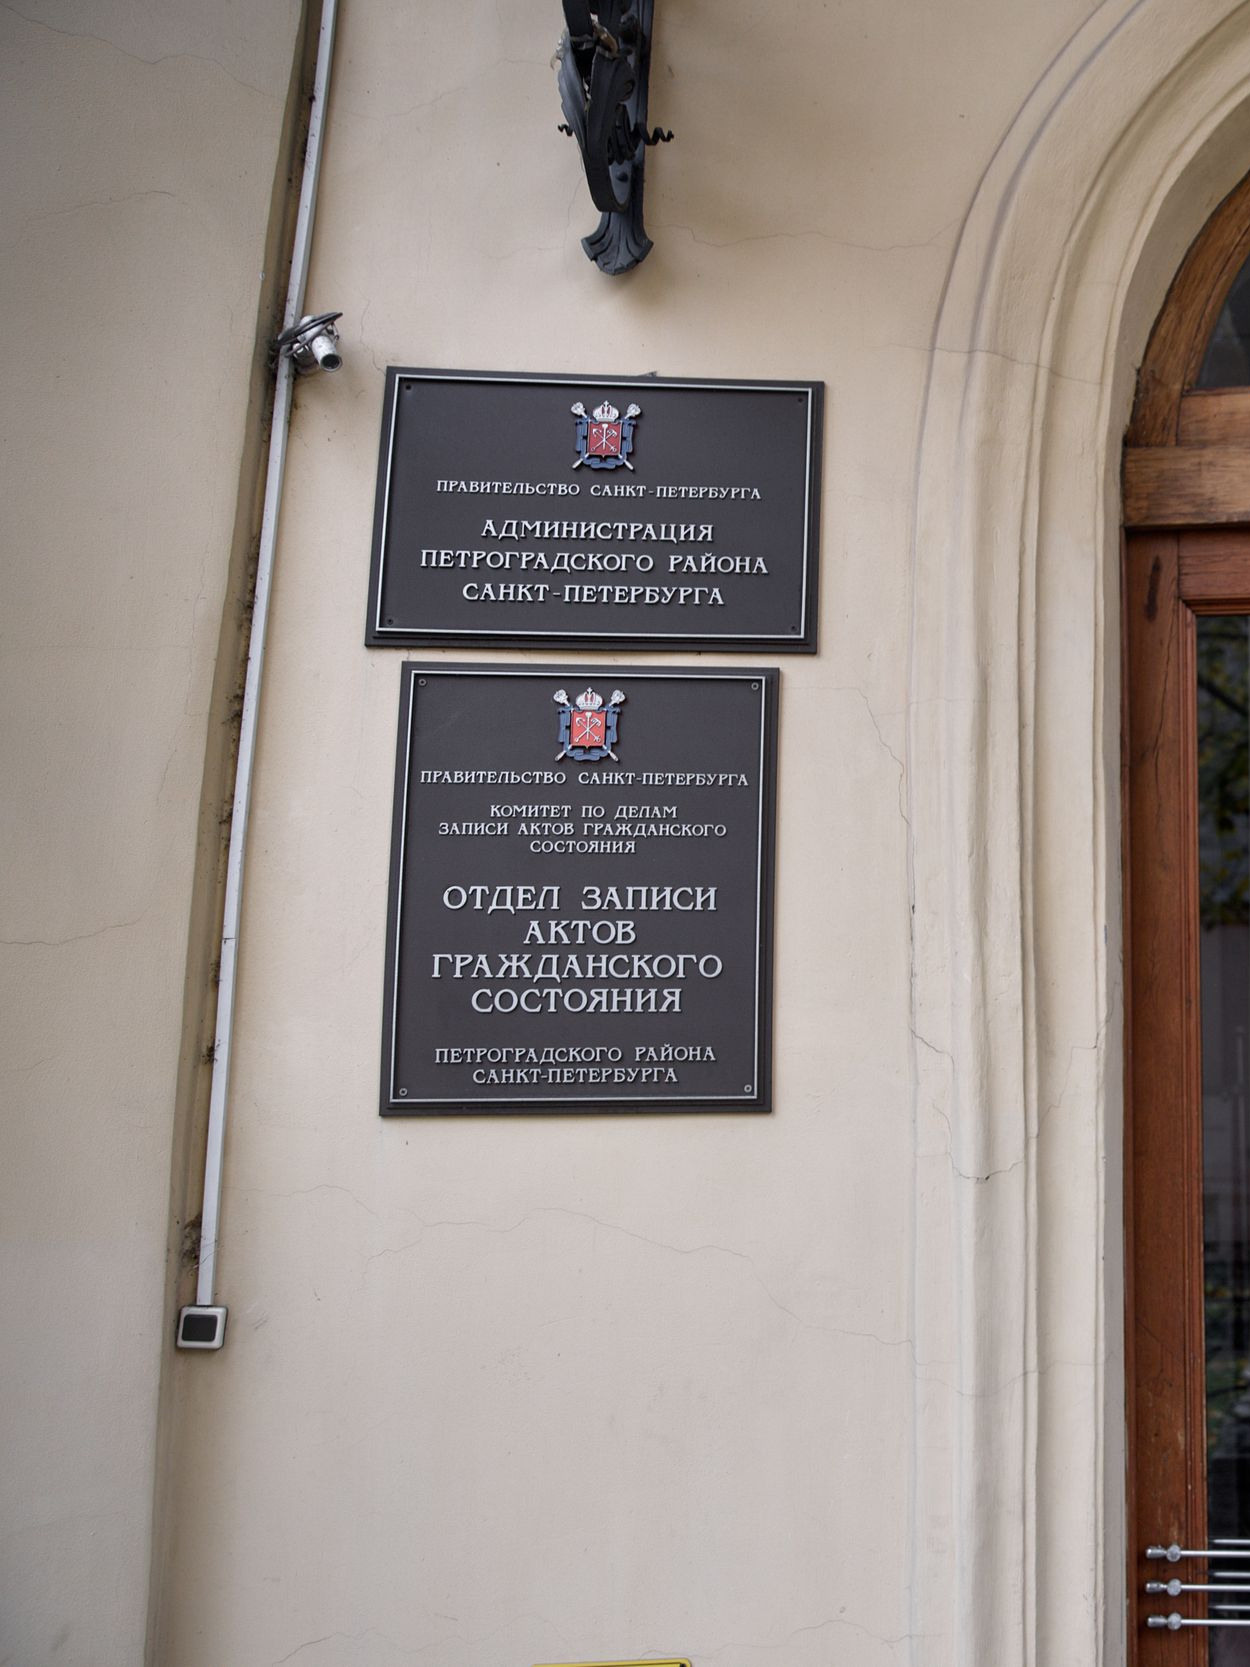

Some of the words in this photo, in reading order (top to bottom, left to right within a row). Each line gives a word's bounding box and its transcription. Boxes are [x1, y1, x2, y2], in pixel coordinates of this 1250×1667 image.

[436, 479, 580, 496] ПРАВИТЕЛЬСТВО
[590, 484, 761, 500] САНКТ-ПЕТЕРБУРГА
[481, 519, 714, 543] АДМИНИСТРАЦИЯ
[420, 549, 653, 572] ПЕТРОГРАДСКОГО
[668, 550, 768, 575] РАЙОНА
[462, 583, 724, 606] САНКТ-ПЕТЕРБУРГА
[420, 770, 566, 784] ПРАВИТЕЛЬСТВО
[578, 771, 749, 787] САНКТ-ПЕТЕРБУРГА
[490, 804, 571, 819] КОМИТЕТ
[581, 805, 604, 819] ПО
[615, 805, 677, 820] ДЕЛАМ
[438, 822, 508, 837] ЗАПИСИ
[518, 823, 574, 837] АКТОВ
[583, 823, 727, 838] ГРАЖДАНСКОГО
[530, 840, 636, 854] СОСТОЯНИЯ
[443, 886, 559, 915] ОТДЕЛ
[582, 887, 717, 911] ЗАПИСИ
[524, 921, 636, 945] АКТОВ
[432, 954, 723, 983] ГРАЖДАНСКОГО
[471, 989, 682, 1014] СОСТОЯНИЯ
[435, 1048, 622, 1065] ПЕТРОГРАДСКОГО
[635, 1044, 716, 1062] РАЙОНА
[472, 1068, 678, 1083] САНКТ-ПЕТЕРБУРГА
